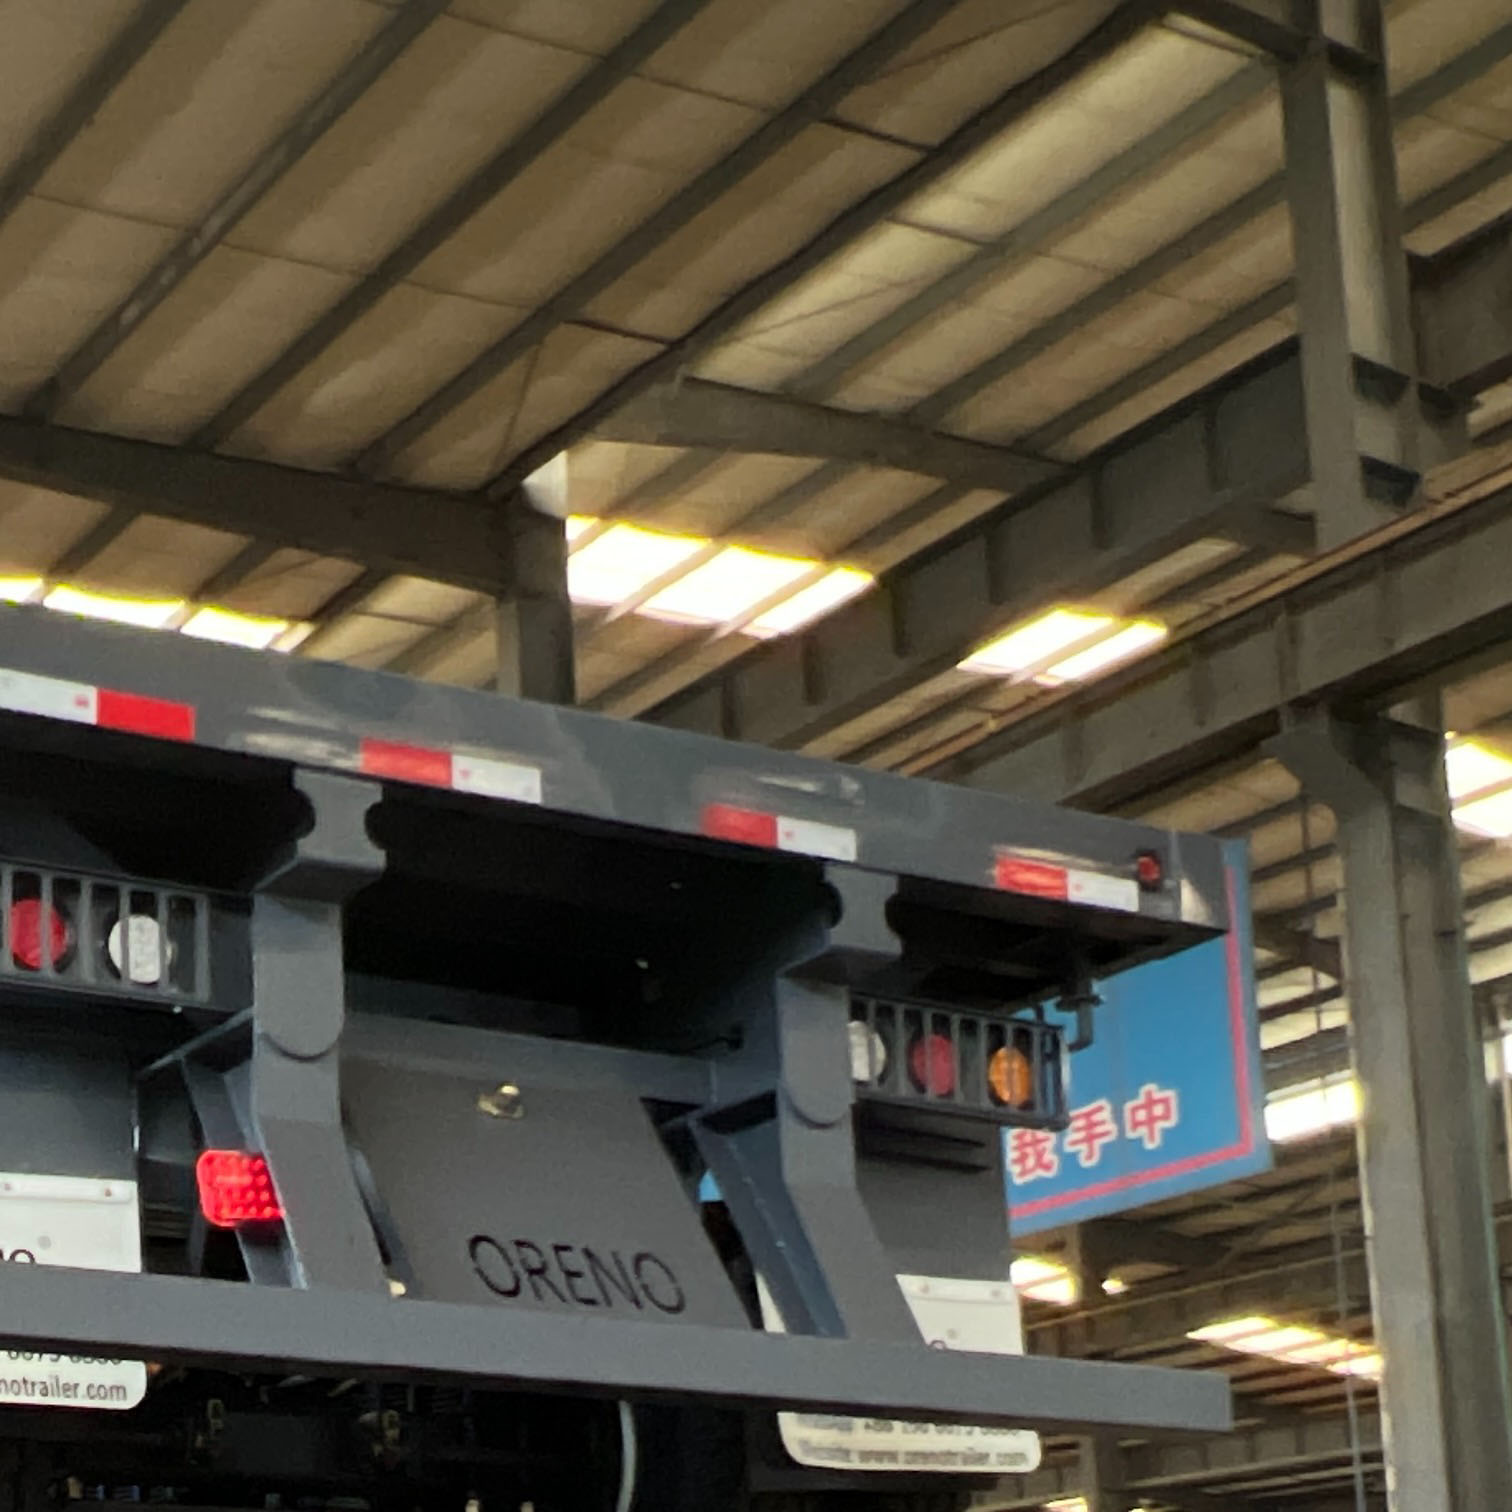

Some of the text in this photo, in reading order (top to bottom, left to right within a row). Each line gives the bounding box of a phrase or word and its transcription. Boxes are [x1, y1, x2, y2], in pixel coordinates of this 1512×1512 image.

[1005, 1083, 1180, 1184] 我手中
[467, 1234, 686, 1315] ORENO
